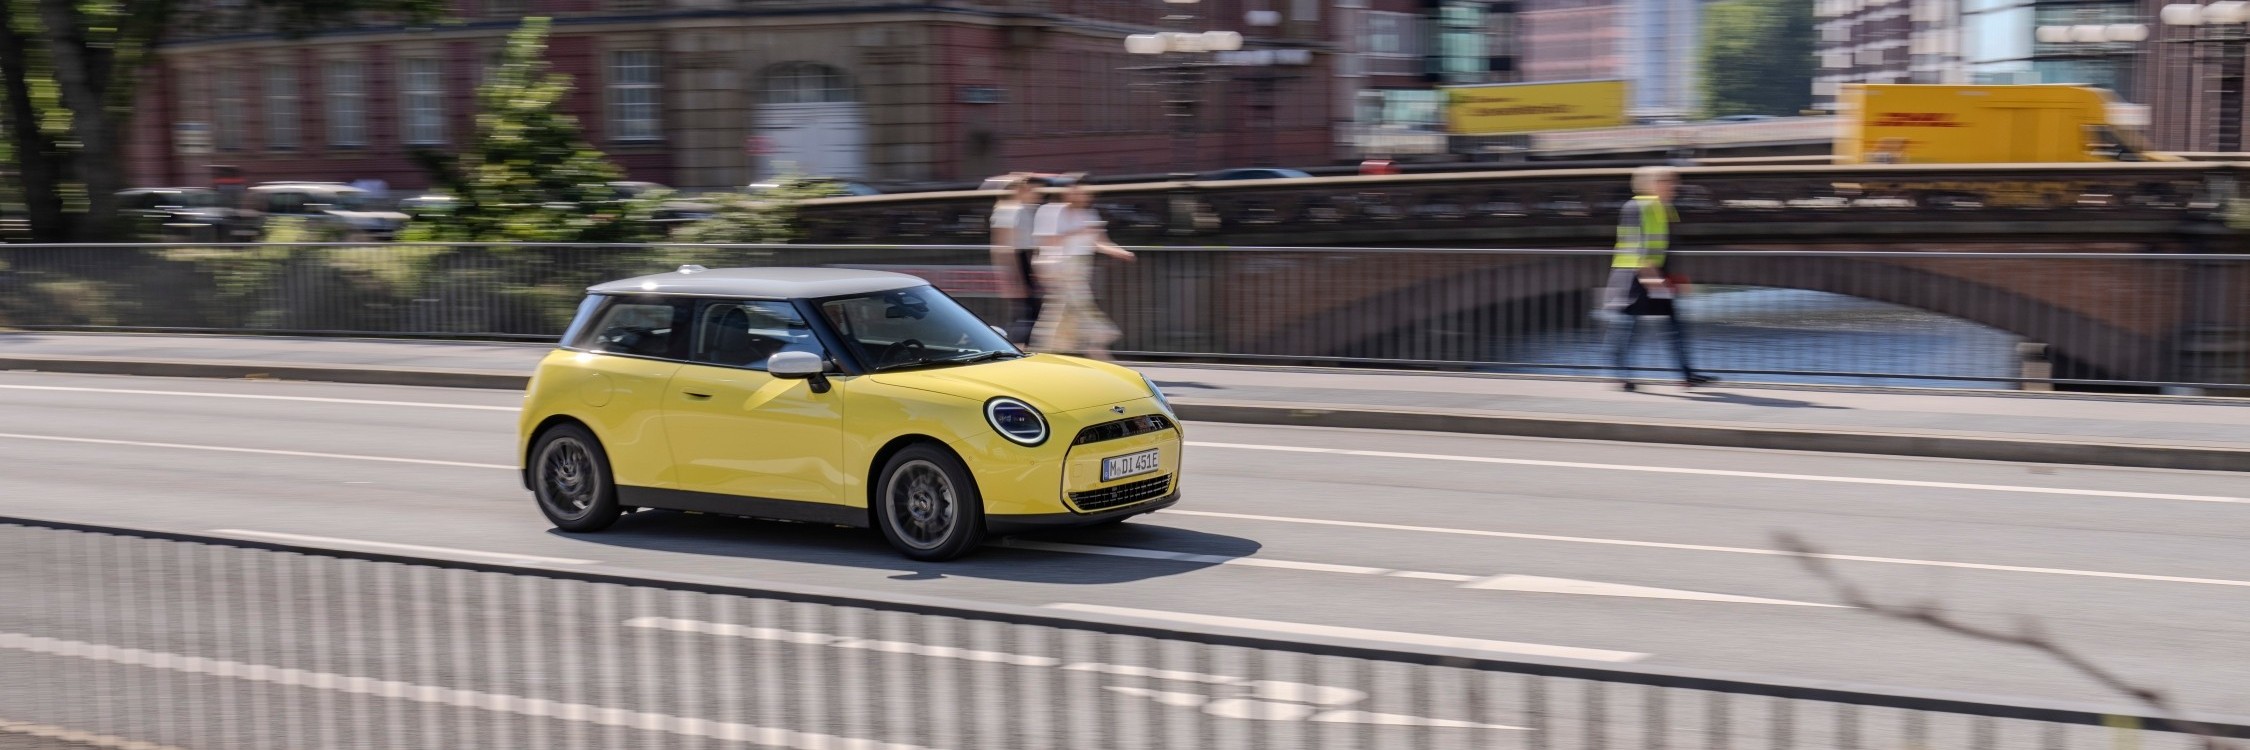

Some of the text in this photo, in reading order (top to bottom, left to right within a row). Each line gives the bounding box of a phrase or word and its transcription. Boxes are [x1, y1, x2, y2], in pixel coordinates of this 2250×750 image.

[1110, 452, 1158, 476] M DI 451E
